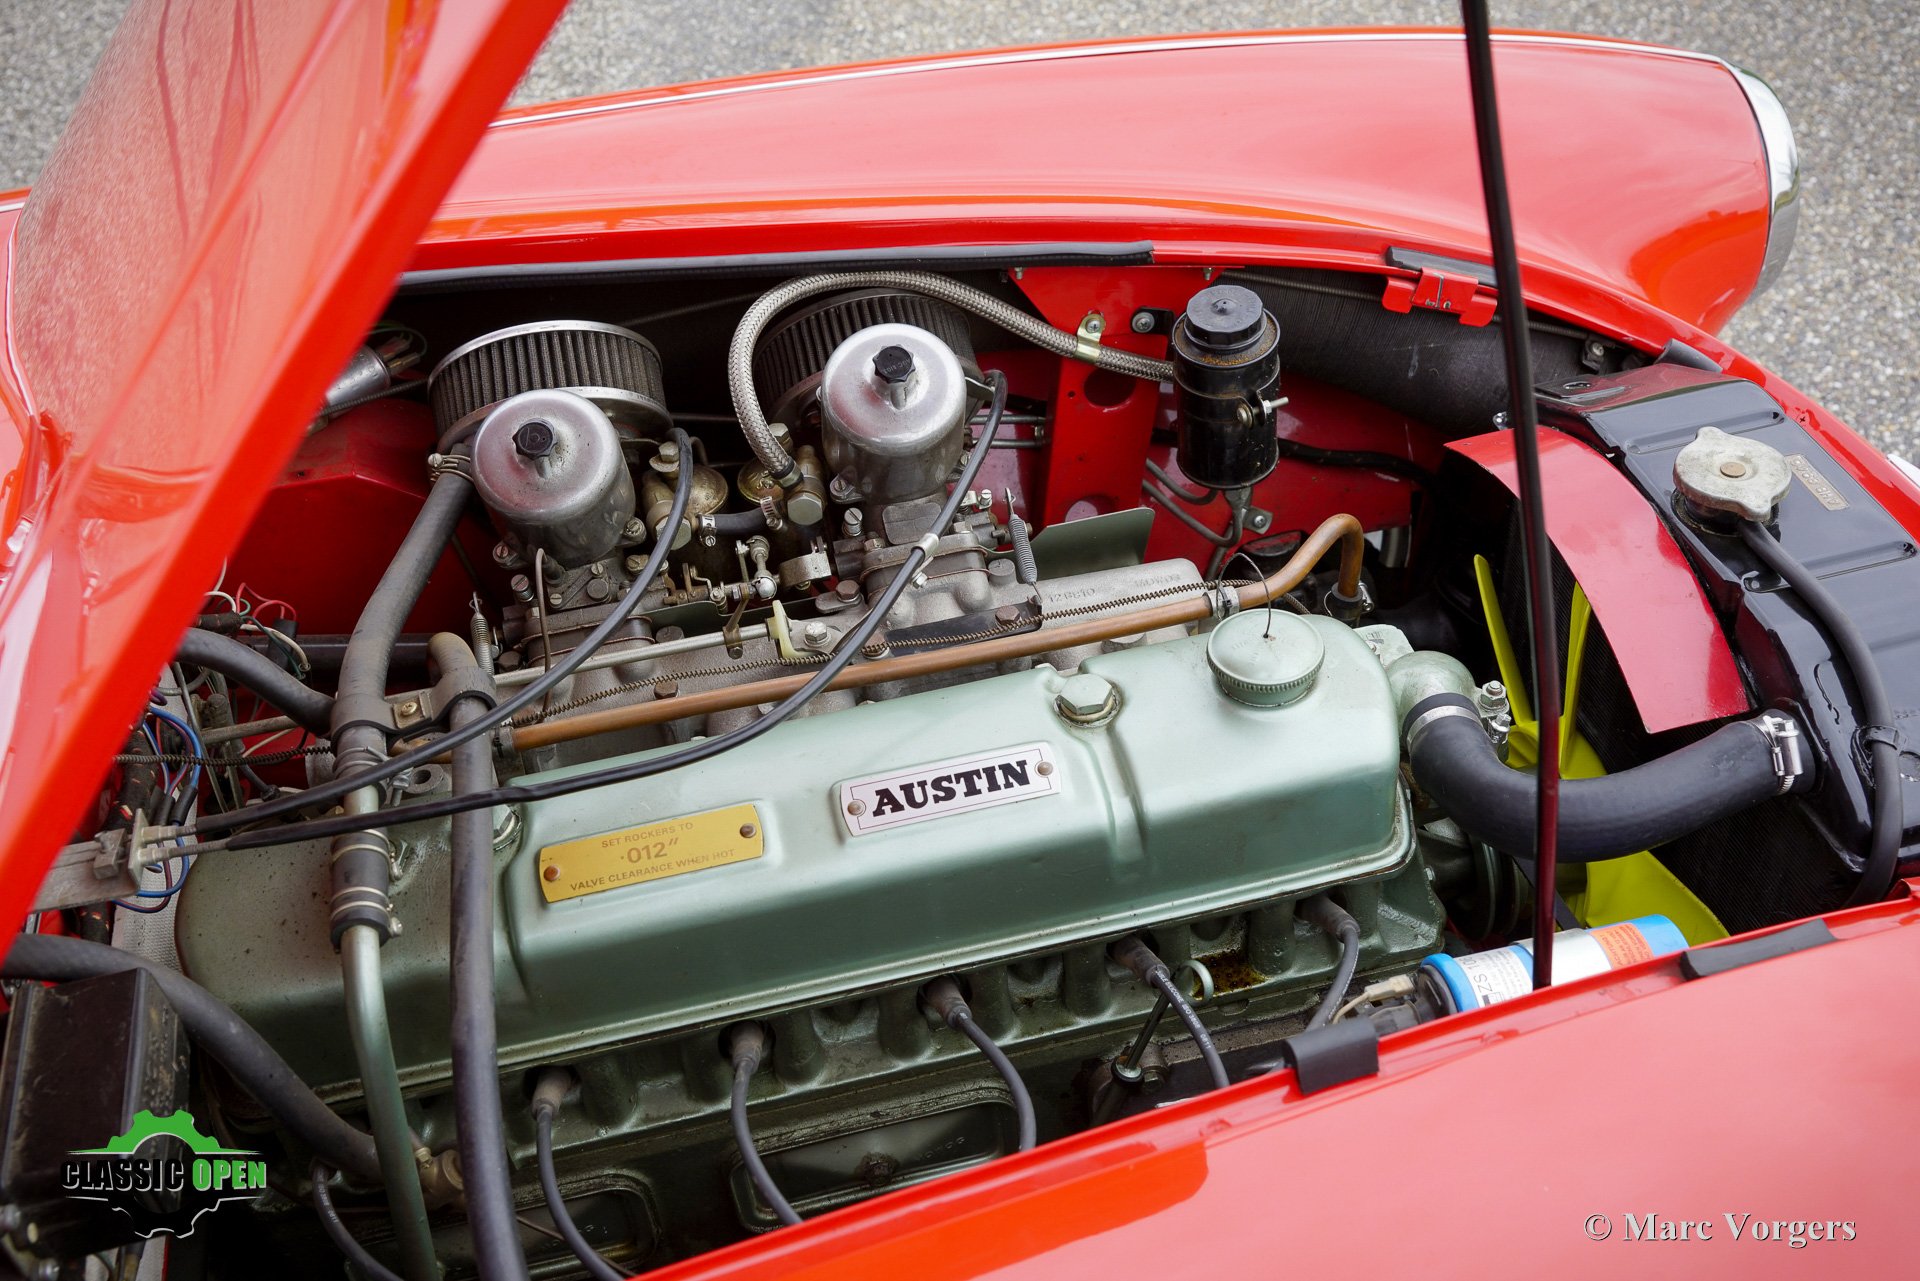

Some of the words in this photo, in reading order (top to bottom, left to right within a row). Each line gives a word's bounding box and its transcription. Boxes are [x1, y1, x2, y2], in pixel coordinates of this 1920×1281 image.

[872, 760, 1030, 817] AUSTIN
[601, 837, 621, 848] SET
[624, 827, 675, 843] ROCKERS
[678, 822, 694, 832] TO
[570, 877, 605, 891] VALVE
[608, 864, 673, 883] CLEARANCE
[675, 855, 710, 868] WHEN
[711, 849, 735, 861] HOT
[1473, 973, 1493, 993] ZS
